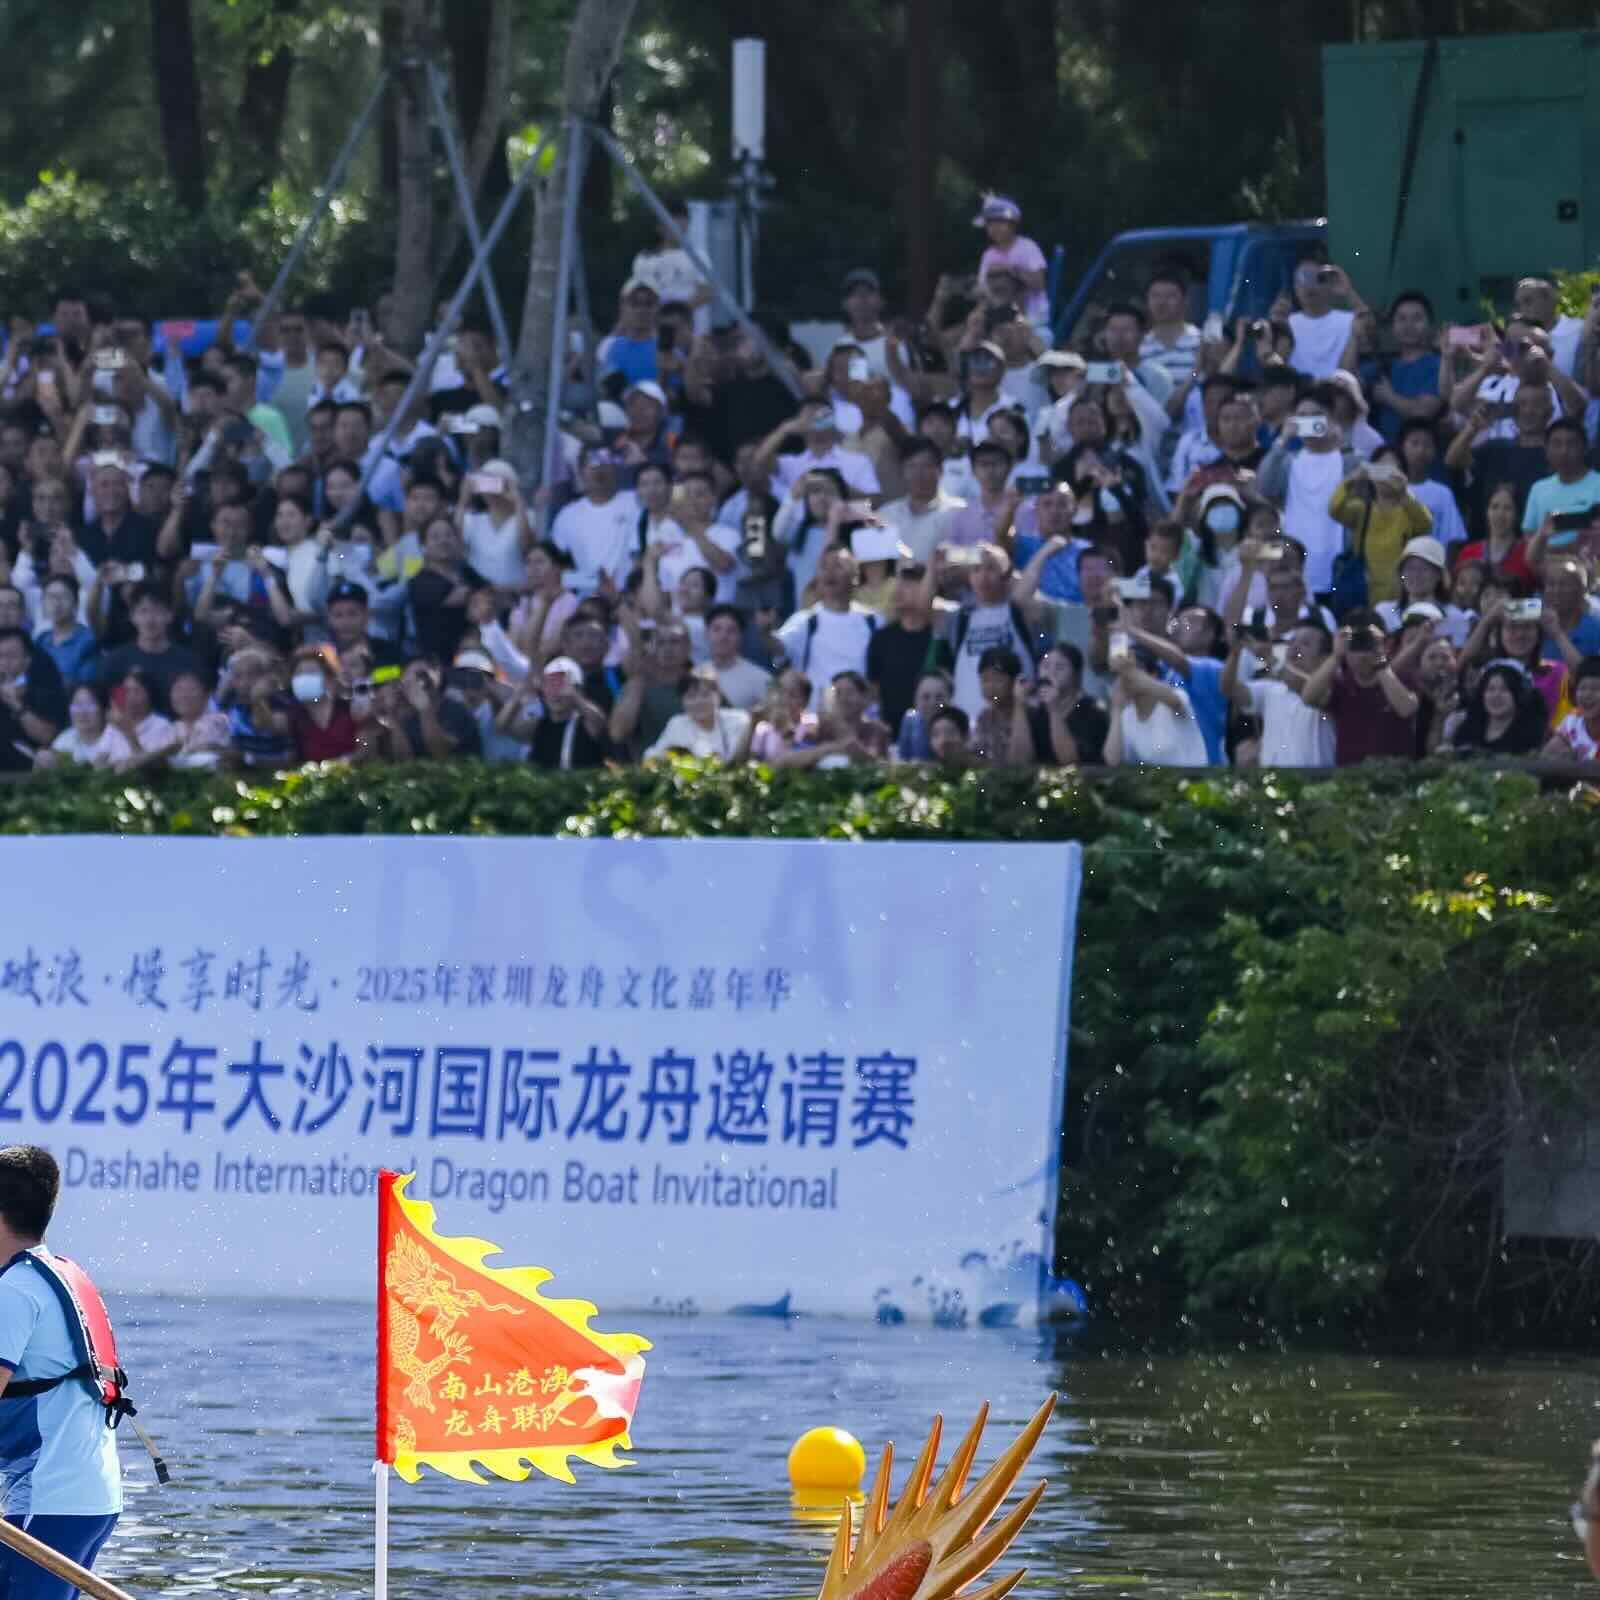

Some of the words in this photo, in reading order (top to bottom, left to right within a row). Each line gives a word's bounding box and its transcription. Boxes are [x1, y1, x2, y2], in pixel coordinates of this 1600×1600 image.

[64, 1147, 199, 1190] Dashahe
[430, 1156, 549, 1213] Dragon
[563, 1160, 640, 1204] Boat
[652, 1161, 839, 1210] Invitational
[438, 1367, 572, 1402] 南山港澳
